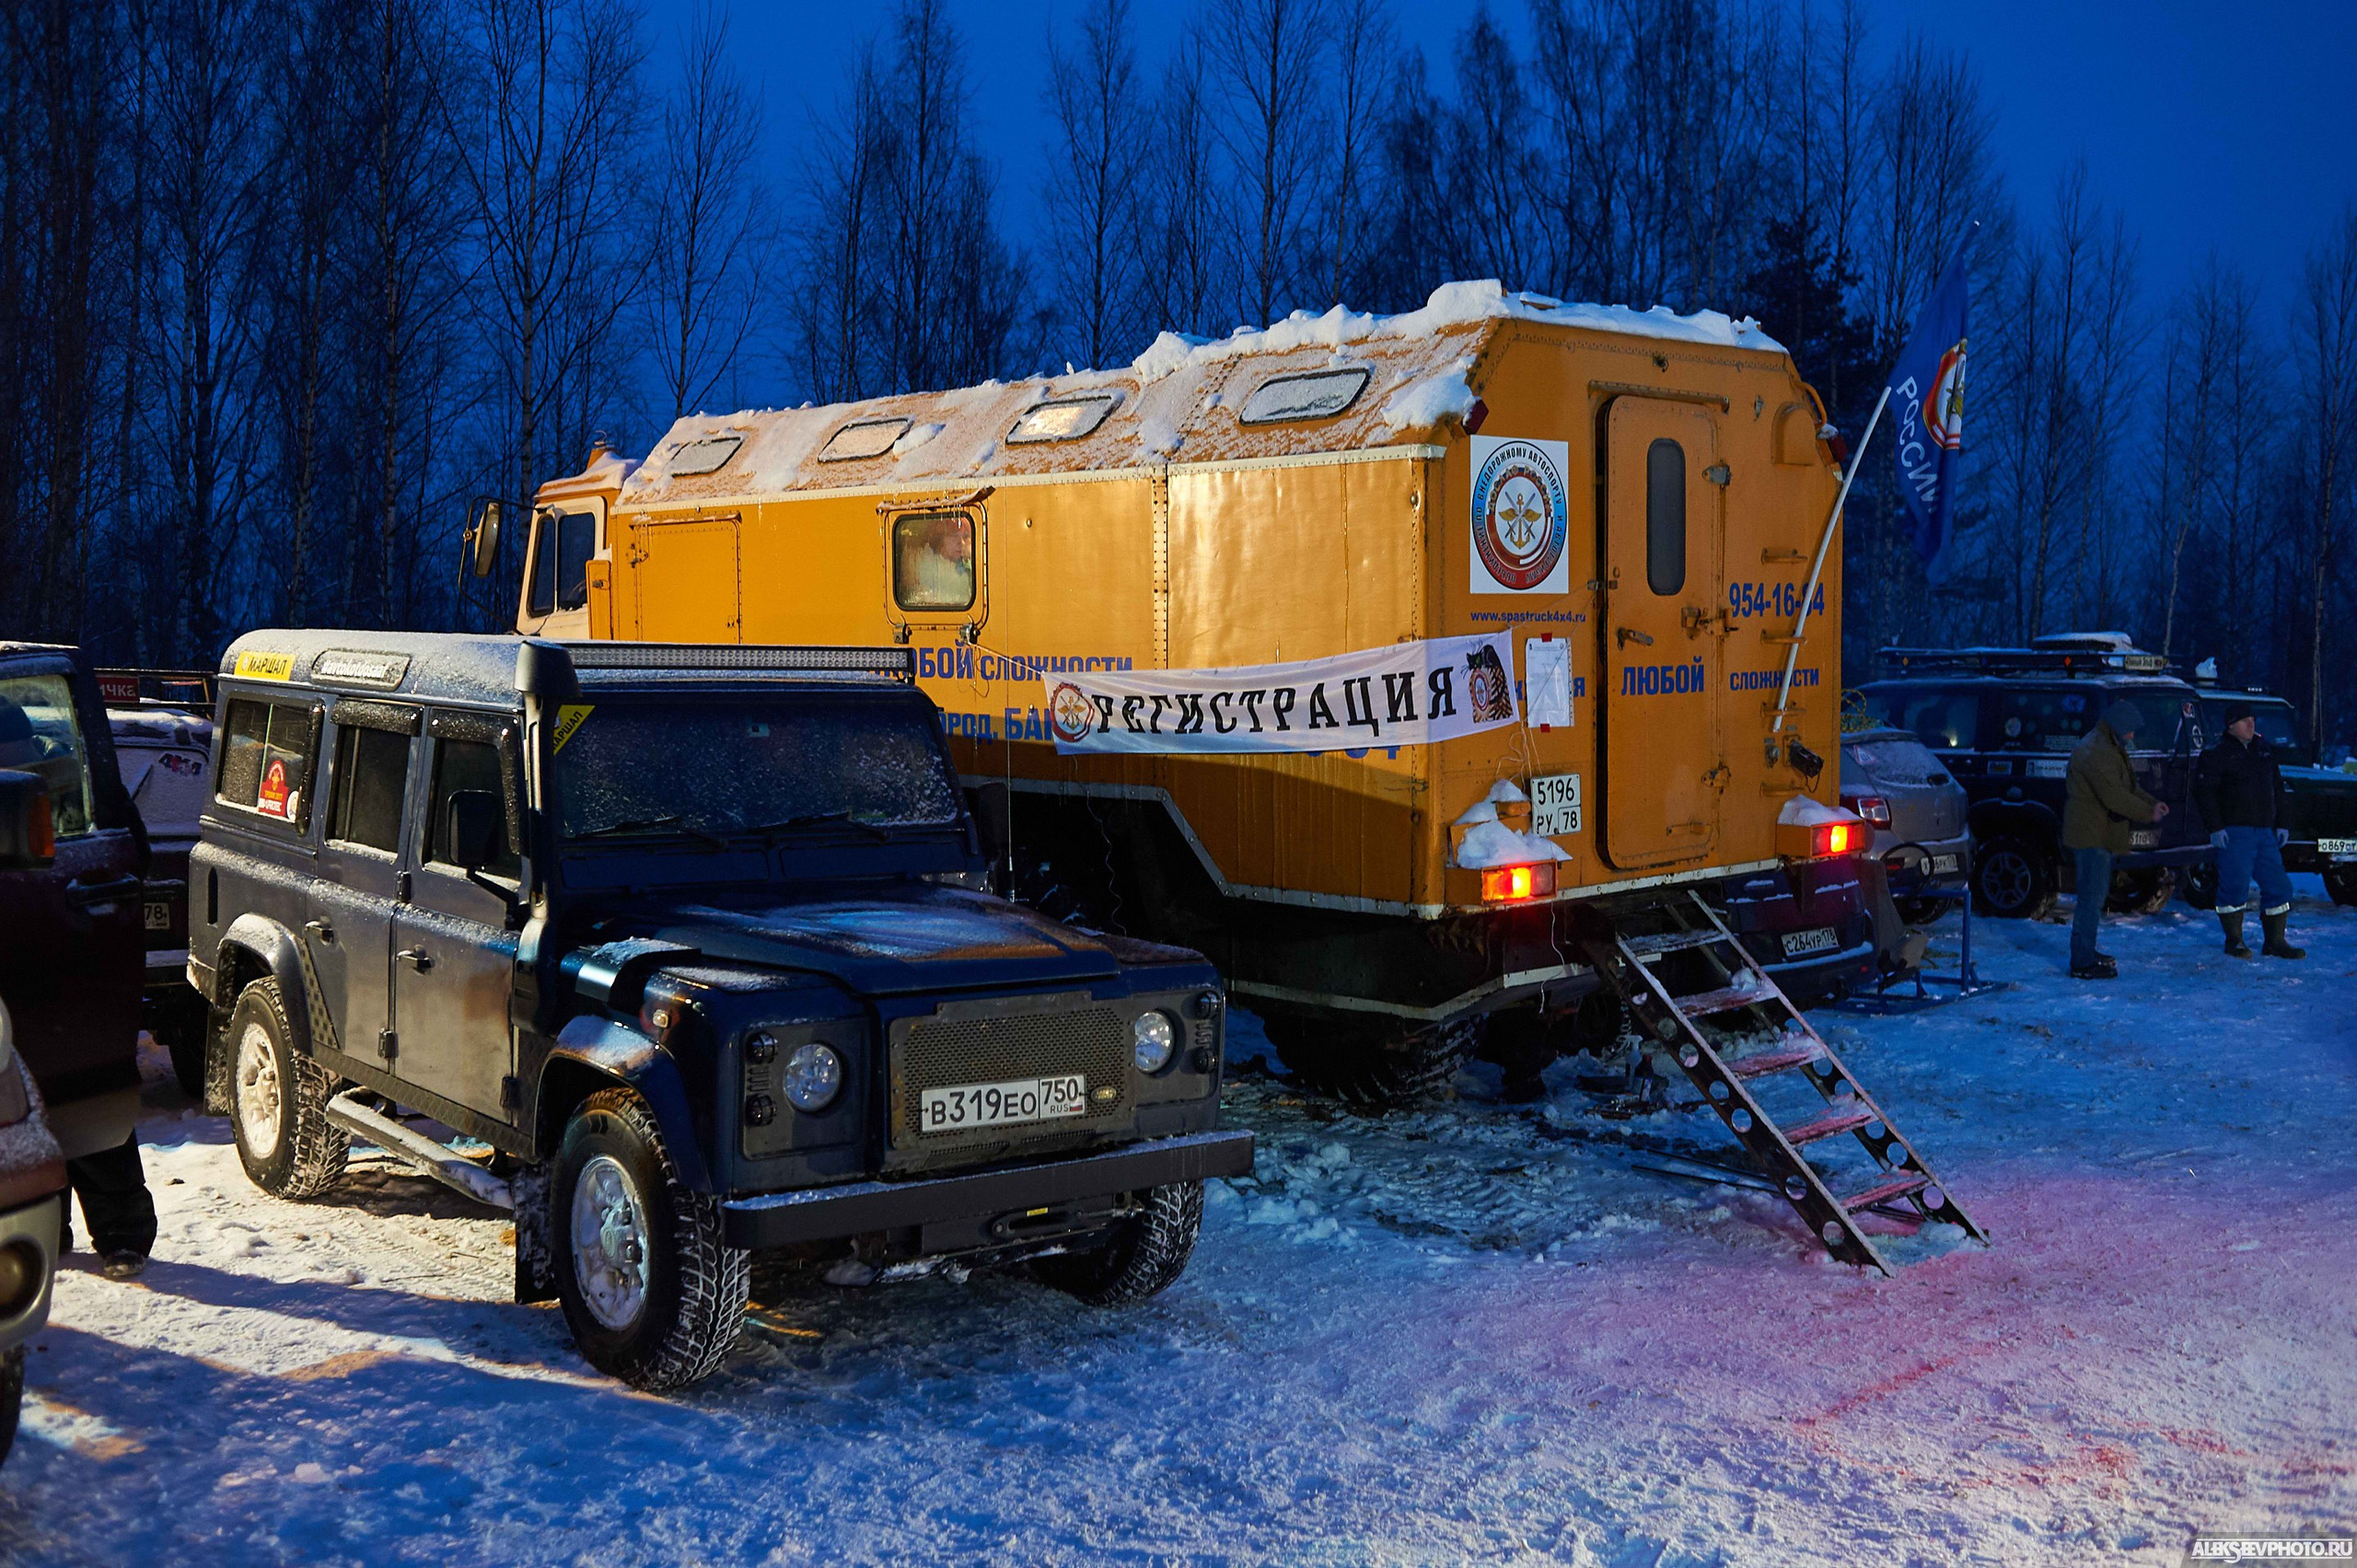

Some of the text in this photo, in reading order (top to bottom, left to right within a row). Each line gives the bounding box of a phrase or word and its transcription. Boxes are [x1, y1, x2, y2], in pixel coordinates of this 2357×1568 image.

[1478, 447, 1527, 500] ВНЕДОРОЖНОМУ
[1528, 450, 1562, 505] АВТОСПОРТУ
[1470, 610, 1586, 622] www.spastruck4x4.ru
[248, 656, 287, 677] МАРШАЛ
[1621, 656, 1704, 696] ЛЮБОЙ
[1091, 667, 1457, 737] РЕГИСТРАЦИЯ
[1537, 778, 1574, 805] 5196
[1537, 810, 1577, 834] РУ 78
[1786, 933, 1822, 953] С264УР
[931, 1078, 1079, 1125] В319ЕО 750
[1050, 1105, 1069, 1114] RUS
